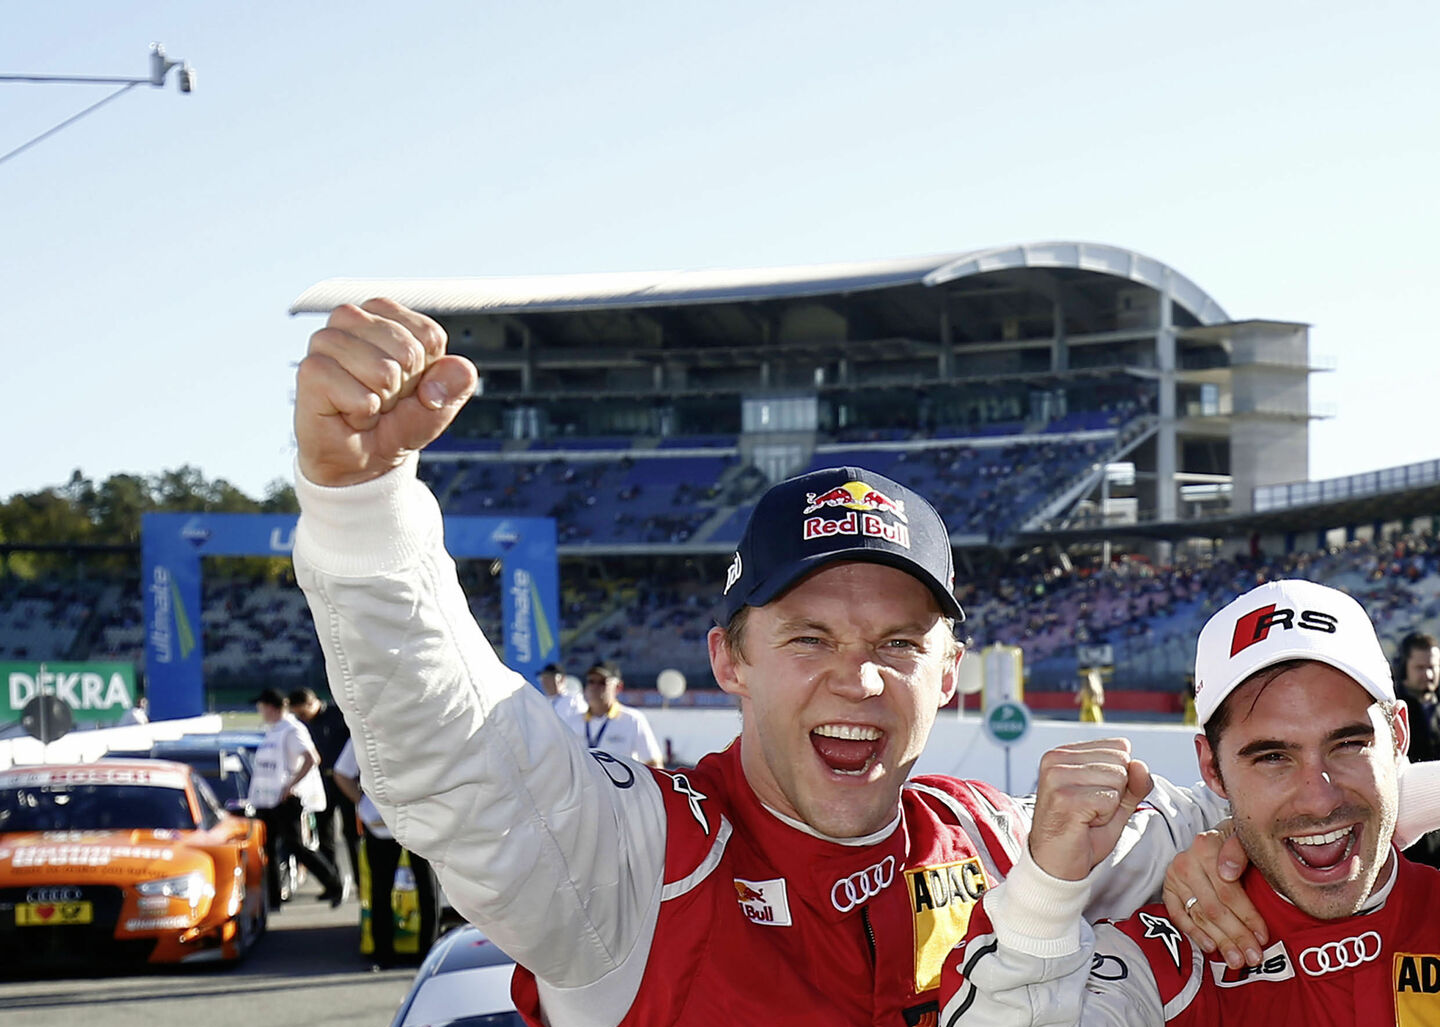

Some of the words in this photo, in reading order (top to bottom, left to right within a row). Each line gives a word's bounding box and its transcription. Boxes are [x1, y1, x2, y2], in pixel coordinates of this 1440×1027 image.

[805, 513, 857, 538] Red
[864, 515, 910, 549] Bull
[9, 672, 132, 710] DEKRA
[914, 863, 984, 912] ADAC
[745, 904, 773, 921] Bull
